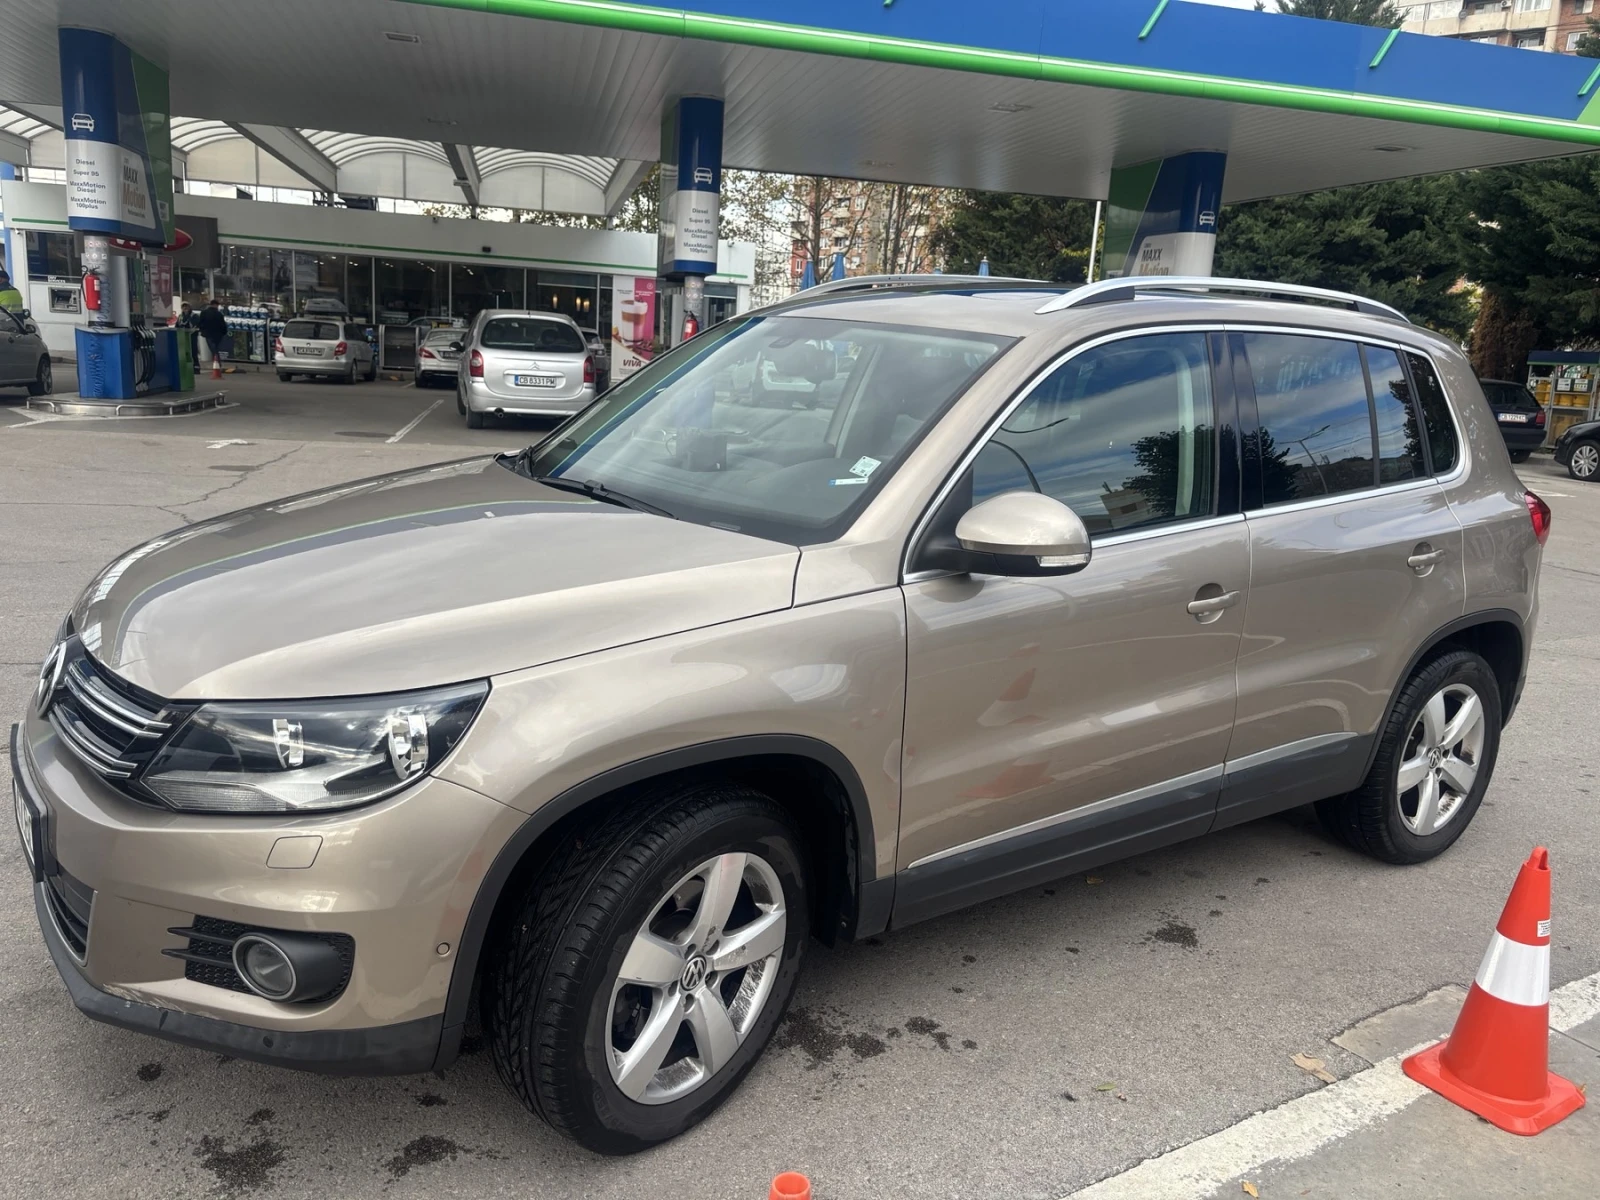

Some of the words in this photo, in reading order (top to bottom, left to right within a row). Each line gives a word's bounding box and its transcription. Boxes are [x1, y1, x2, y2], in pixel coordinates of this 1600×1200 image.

[123, 165, 138, 184] MAXX
[70, 181, 106, 189] MaxxMotion
[71, 197, 106, 205] MaxxMotion
[123, 182, 146, 210] Motion
[1142, 248, 1162, 261] MAXX
